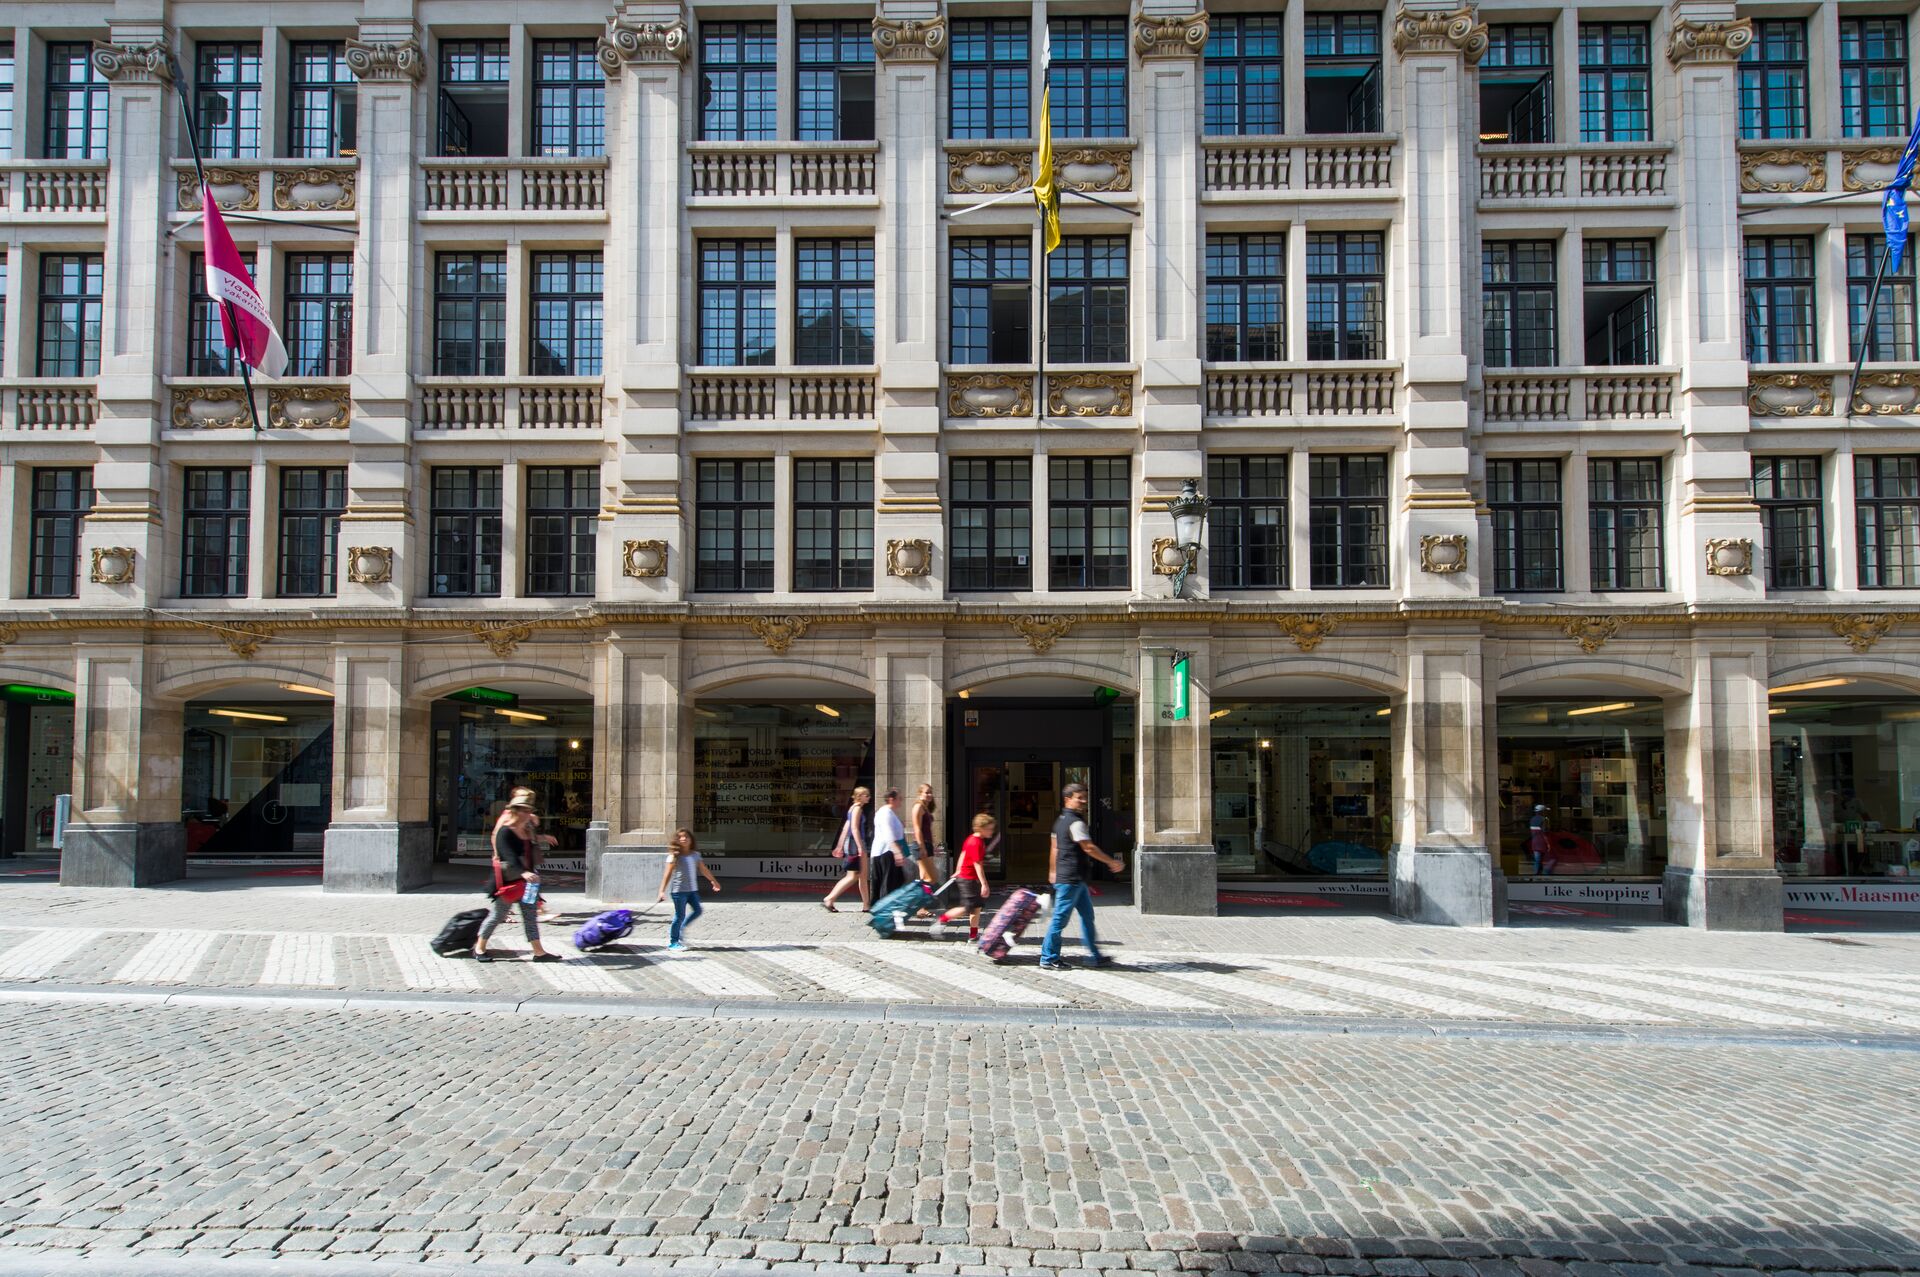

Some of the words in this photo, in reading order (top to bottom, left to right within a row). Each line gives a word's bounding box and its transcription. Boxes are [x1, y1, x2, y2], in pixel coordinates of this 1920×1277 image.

[759, 860, 793, 873] Like
[1544, 885, 1573, 897] Like
[1578, 885, 1651, 902] shopping
